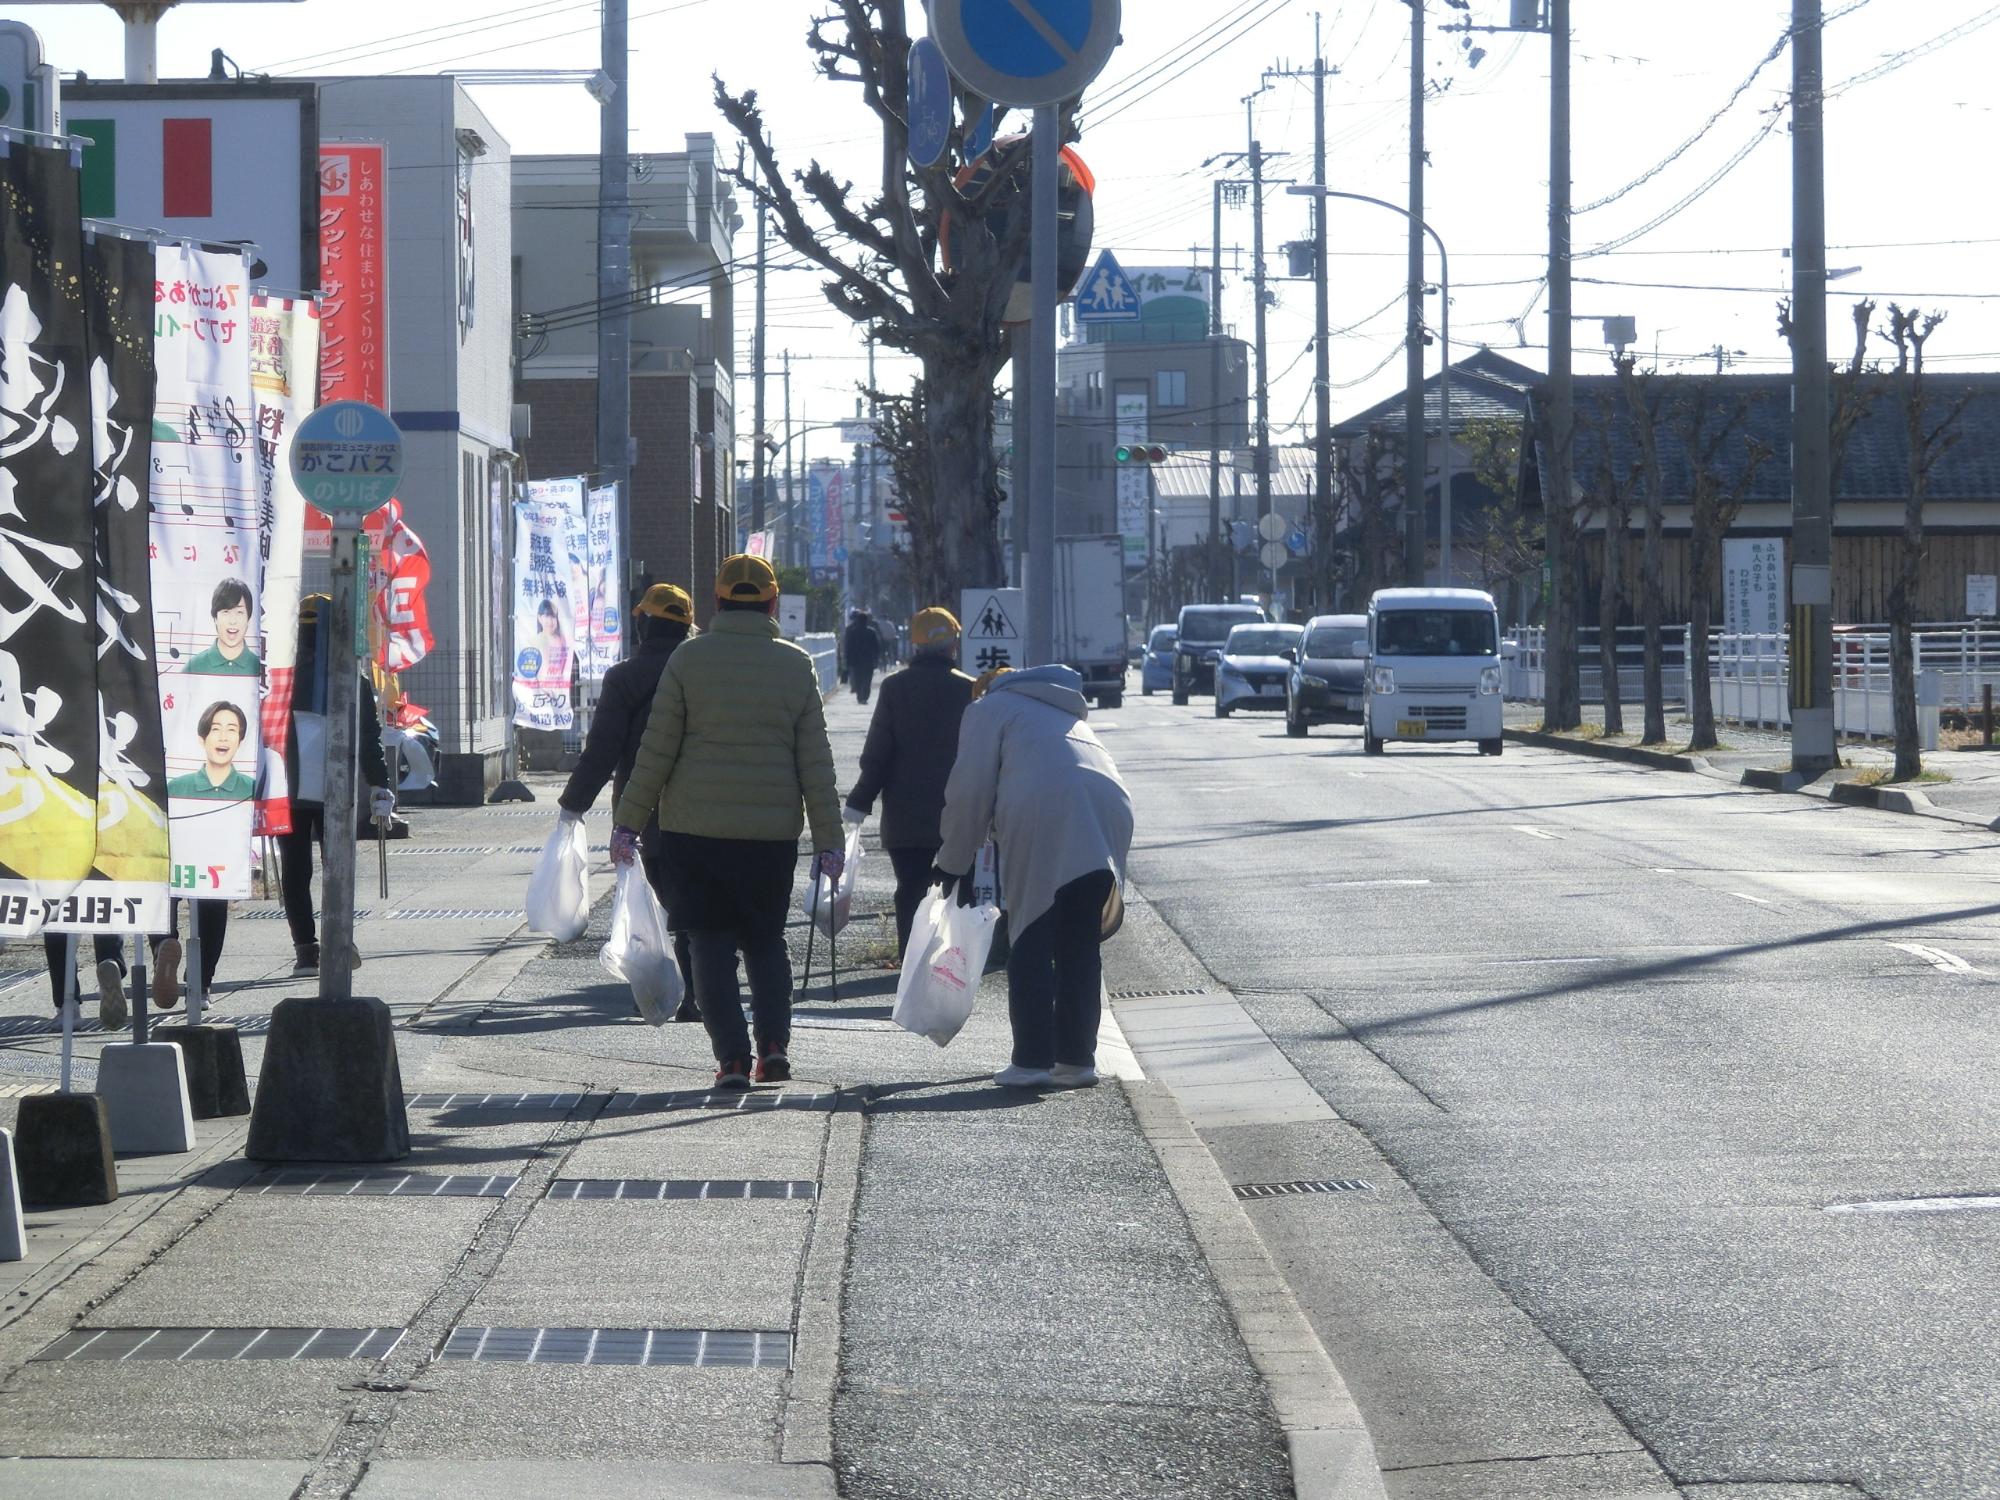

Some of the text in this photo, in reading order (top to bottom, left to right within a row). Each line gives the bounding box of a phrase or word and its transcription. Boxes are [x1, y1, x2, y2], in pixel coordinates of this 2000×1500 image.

[301, 453, 394, 472] かこバス
[314, 481, 381, 502] のりば
[975, 646, 1011, 674] 歩
